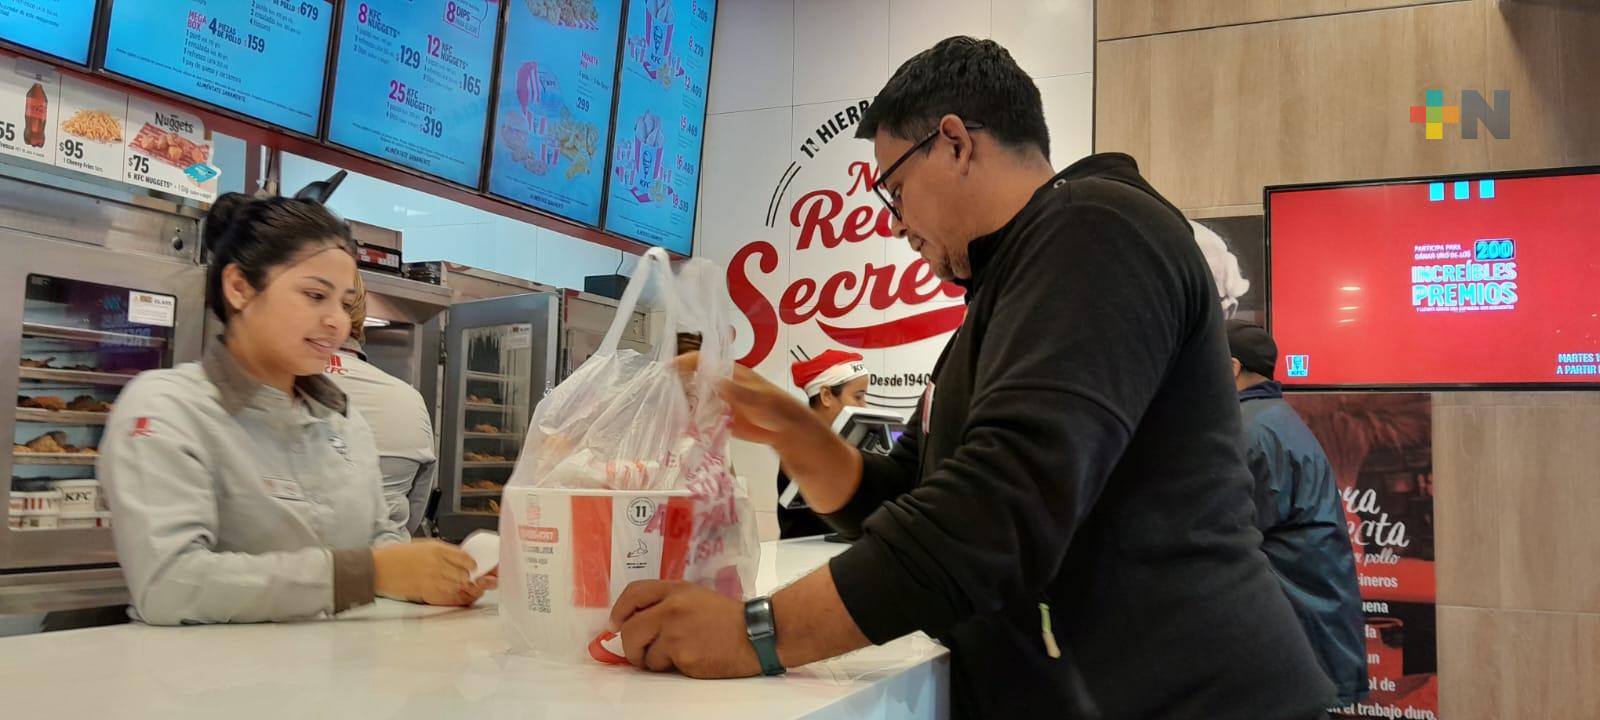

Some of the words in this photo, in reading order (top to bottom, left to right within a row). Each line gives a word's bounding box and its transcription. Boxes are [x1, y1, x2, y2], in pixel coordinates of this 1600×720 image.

[188, 10, 207, 24] MEGA
[358, 3, 368, 24] 8
[368, 8, 382, 22] KFC
[446, 1, 456, 23] 8
[456, 6, 471, 21] DIPS
[187, 20, 201, 31] BOX
[209, 17, 217, 35] 4
[218, 23, 236, 35] PIEZAS
[217, 30, 224, 39] DE
[225, 33, 242, 46] POLLO
[427, 34, 440, 57] 12
[441, 43, 453, 54] KFC
[389, 79, 406, 103] 25
[406, 88, 419, 99] KFC
[155, 112, 194, 133] Nuggets
[59, 139, 84, 159] $95
[128, 155, 150, 174] $75
[133, 174, 144, 182] KFC
[1475, 240, 1514, 260] 200
[1411, 259, 1518, 283] INCREÍBLES
[1412, 281, 1518, 306] PREMIOS
[726, 240, 966, 369] Secre
[1558, 353, 1594, 363] MARTES
[1556, 365, 1563, 375] A
[1564, 365, 1597, 375] PARTIR
[869, 373, 903, 387] Desde
[904, 373, 931, 387] 1940
[65, 492, 91, 502] KFC
[1338, 486, 1381, 514] ra
[636, 505, 647, 518] 11
[1347, 513, 1410, 547] ecta
[1364, 547, 1401, 567] pollo
[1357, 573, 1399, 588] ineros
[1380, 678, 1396, 691] de
[1357, 703, 1402, 720] trabajo
